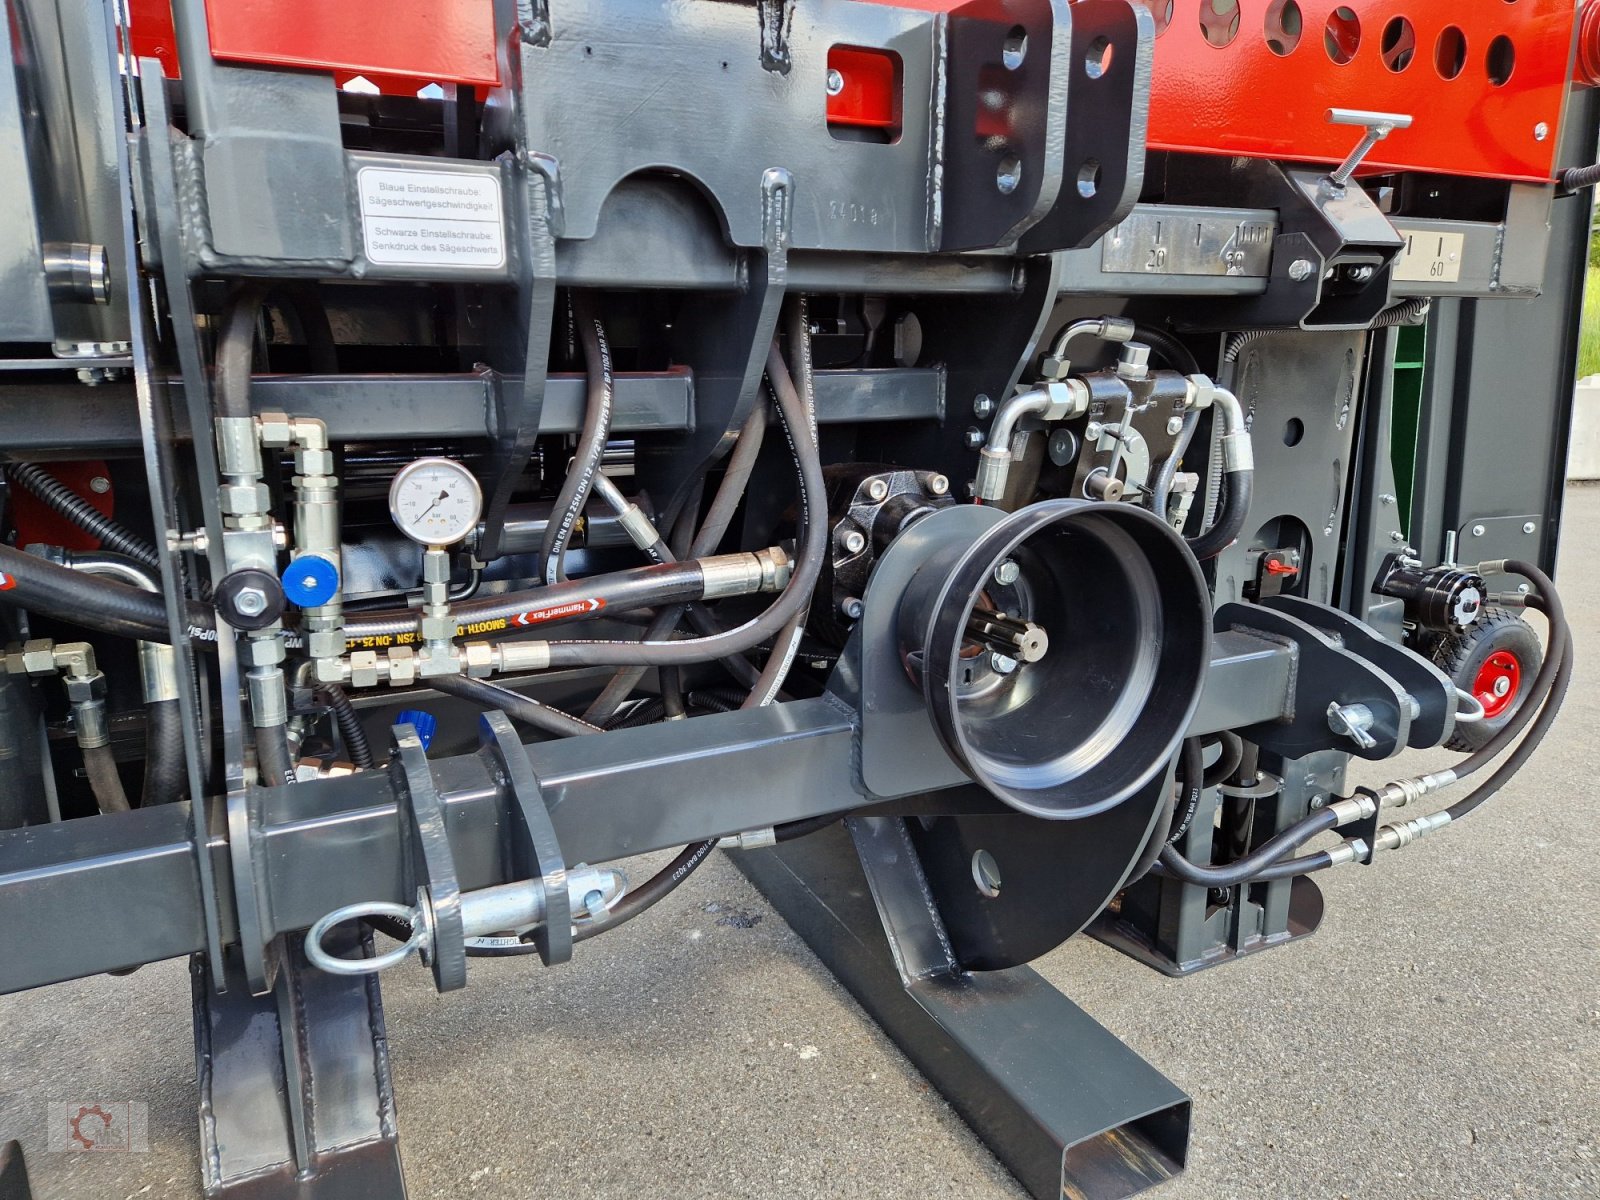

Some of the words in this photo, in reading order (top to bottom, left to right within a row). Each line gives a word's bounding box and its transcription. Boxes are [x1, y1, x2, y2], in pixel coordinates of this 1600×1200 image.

[378, 182, 405, 192] Blaue
[374, 227, 418, 238] Schwarze
[372, 241, 419, 251] Senkdruck
[420, 243, 438, 252] des
[439, 244, 498, 254] Sägeschwerts
[1147, 249, 1165, 268] 20
[1226, 252, 1244, 268] 30
[1430, 262, 1444, 276] 60
[598, 338, 608, 354] BAR
[604, 372, 612, 384] BP
[603, 390, 612, 408] BAR
[597, 424, 606, 440] WP
[584, 467, 593, 478] 12
[578, 479, 589, 494] DN
[1174, 519, 1182, 528] P
[558, 528, 568, 540] EN
[552, 540, 563, 553] DIN
[532, 602, 585, 619] HammerFlex
[468, 618, 506, 634] SMOOTH
[362, 637, 374, 647] 25
[397, 632, 415, 643] 2SN
[697, 844, 708, 857] 1100
[686, 854, 698, 868] BAR
[672, 864, 687, 880] 3Q23
